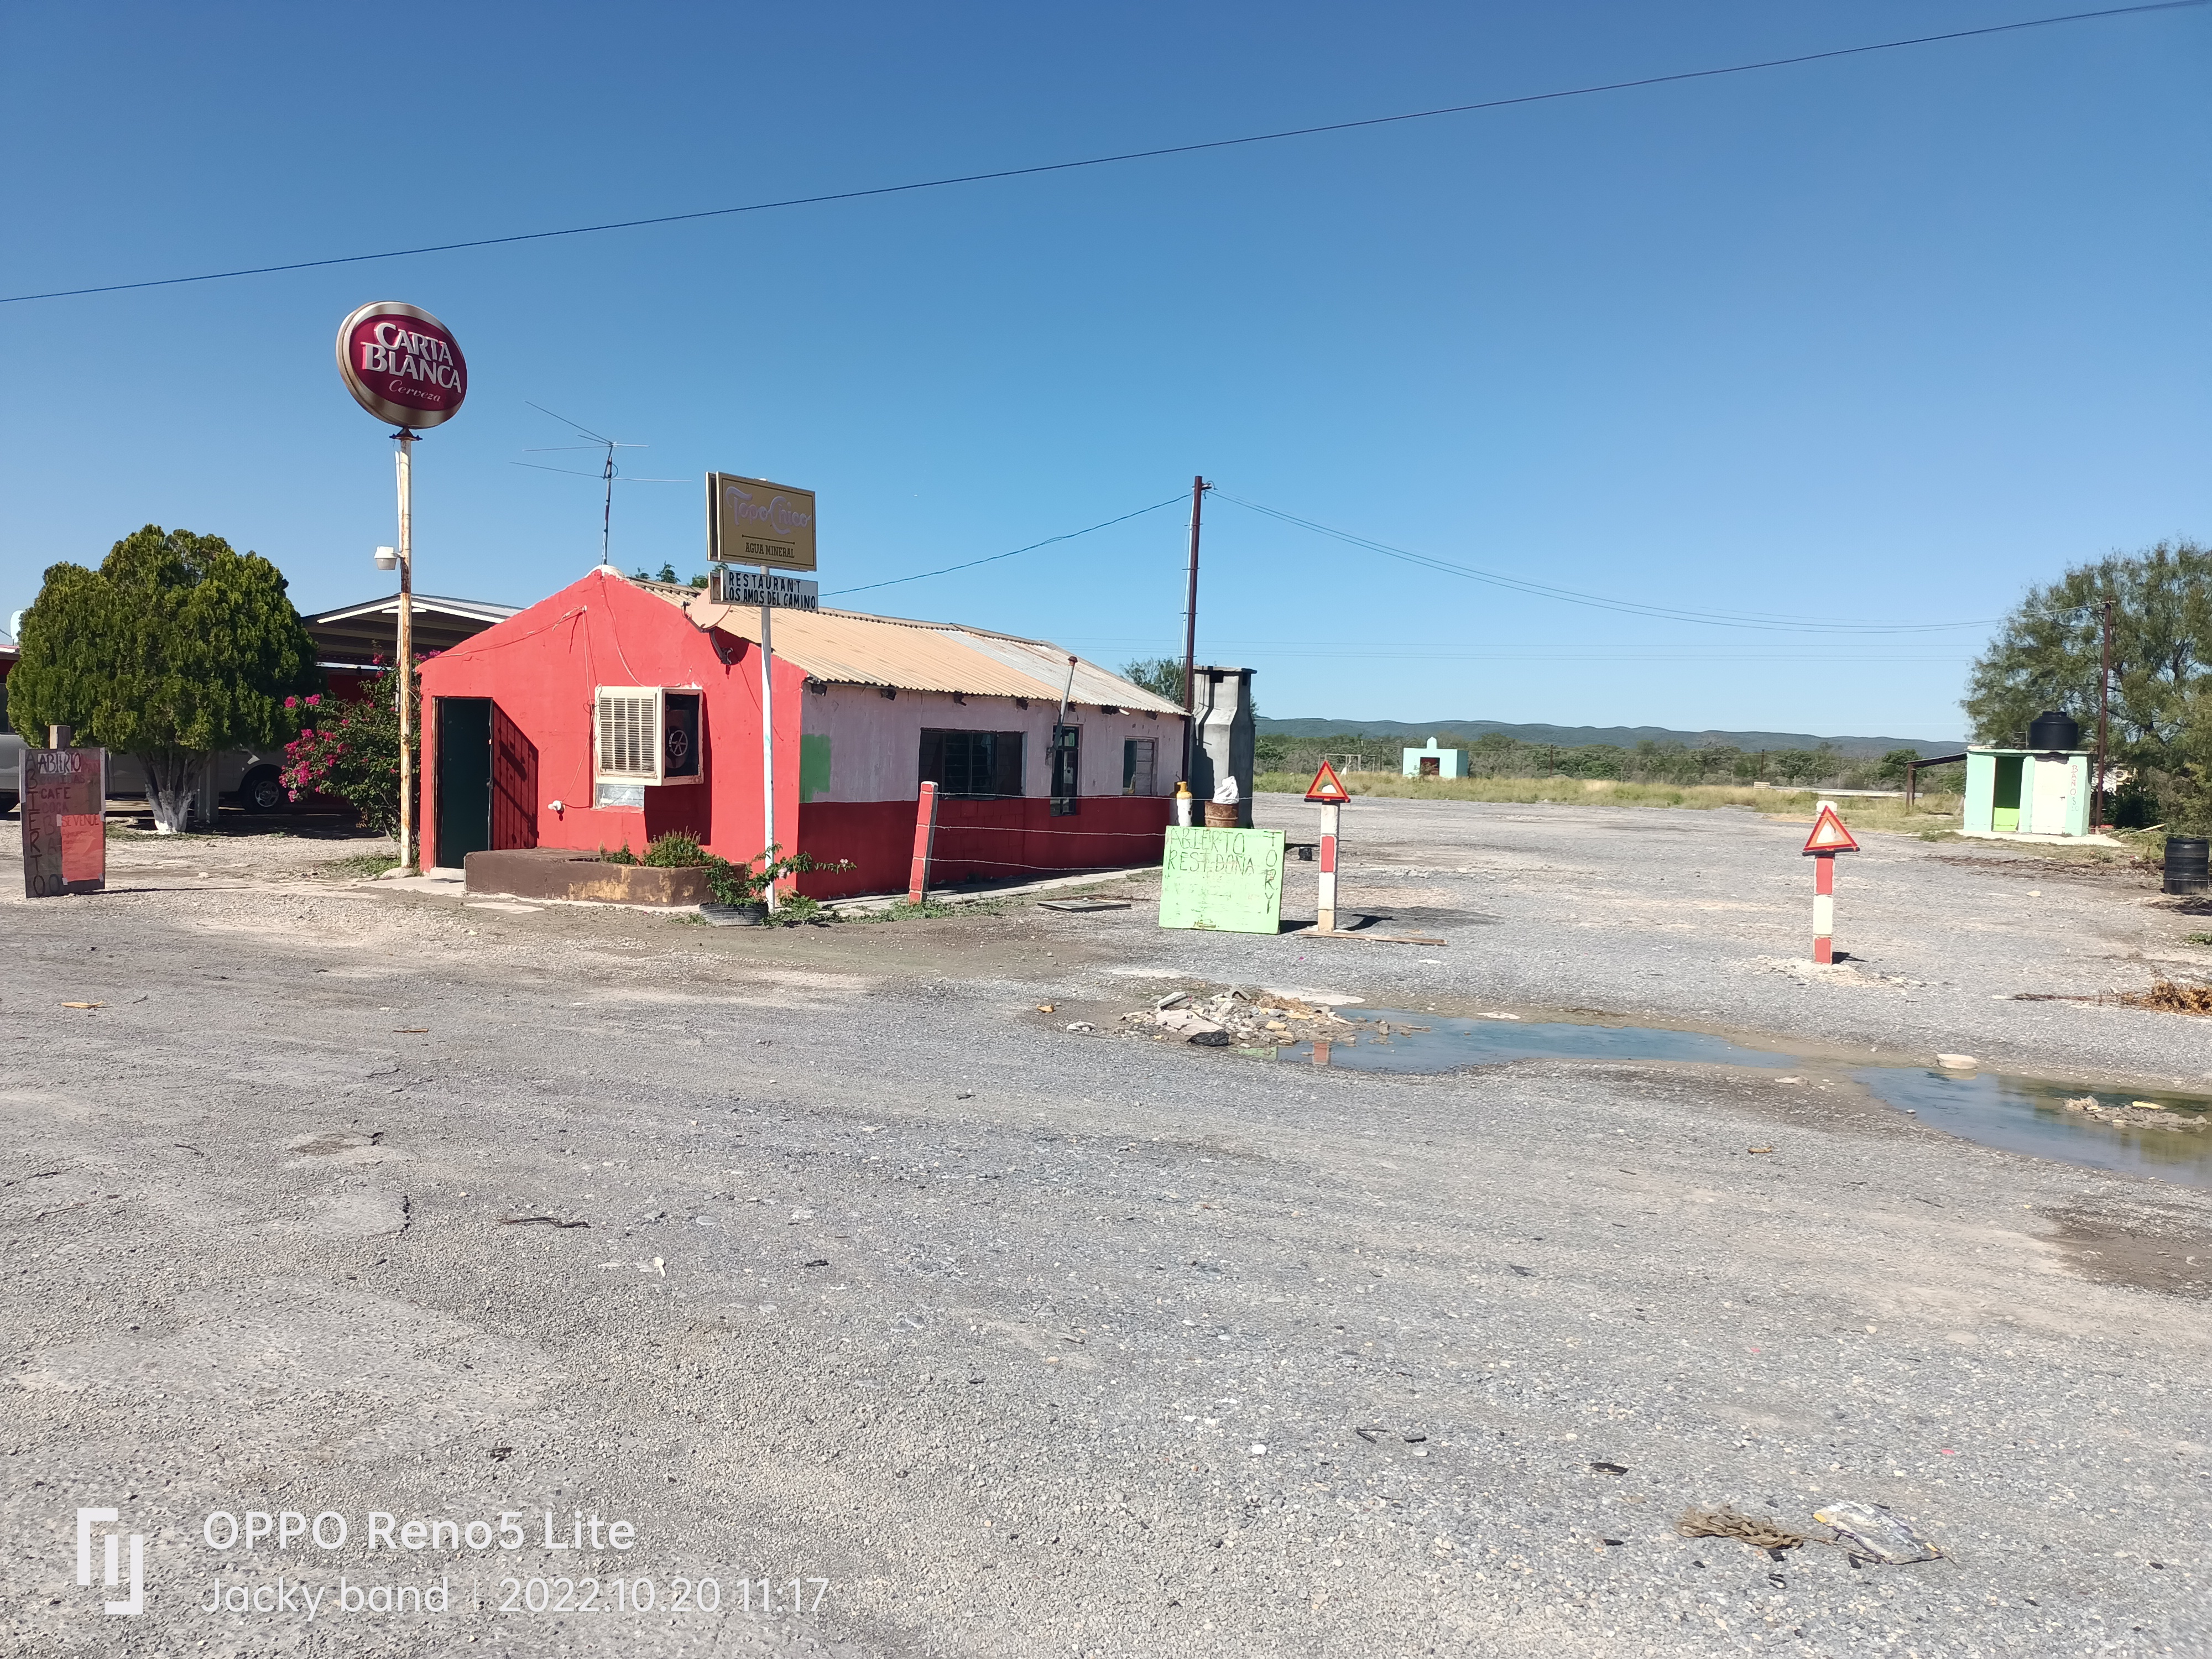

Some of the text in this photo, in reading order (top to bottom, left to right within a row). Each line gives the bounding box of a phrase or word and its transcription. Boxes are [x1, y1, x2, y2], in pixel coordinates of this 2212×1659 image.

[374, 322, 453, 367] CARTA
[361, 342, 461, 393] BLANCA
[389, 379, 441, 402] Cerveza
[725, 486, 811, 535] Topo Chico
[745, 542, 795, 558] AGUA MINERAL
[729, 571, 801, 593] RESTAURANT
[724, 586, 816, 609] LOS AMOS DEL CAMINO
[37, 752, 81, 774] ABIERTO
[40, 787, 71, 800] CAFE
[25, 750, 46, 896] ABIERTO
[1170, 827, 1245, 855] ABIERTO
